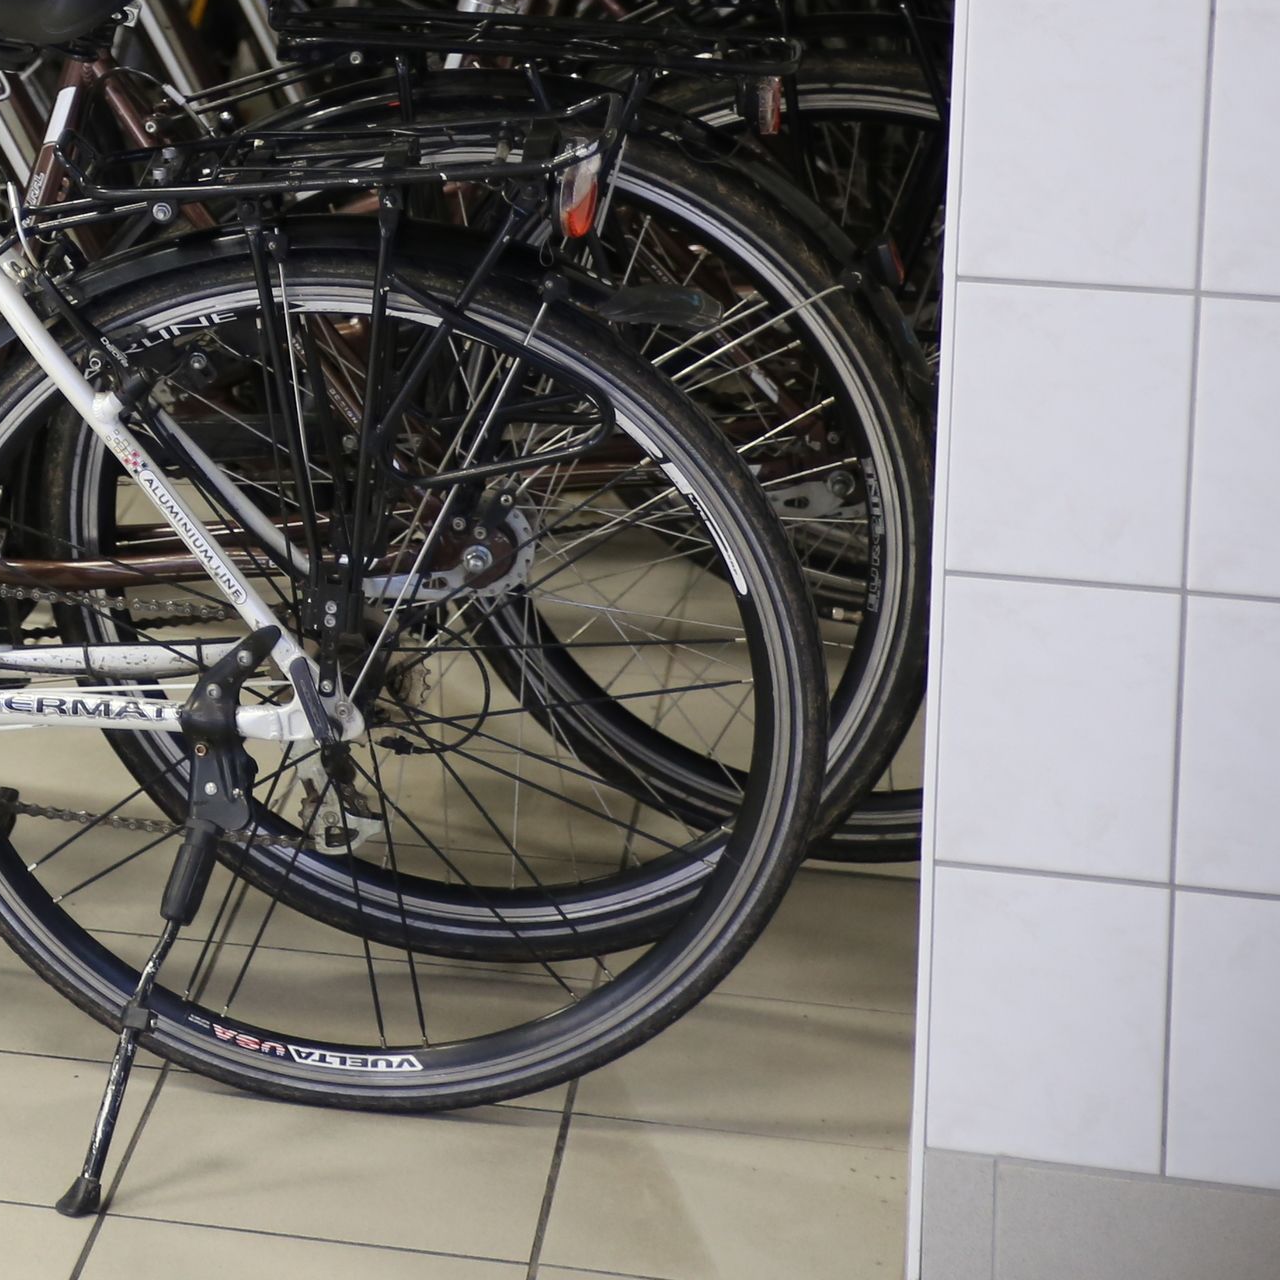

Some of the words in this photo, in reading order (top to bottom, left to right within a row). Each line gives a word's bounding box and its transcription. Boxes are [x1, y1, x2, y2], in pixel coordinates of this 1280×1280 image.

[143, 477, 214, 565] ALUMINIUM
[214, 568, 243, 603] LINE
[212, 1023, 286, 1057] USA
[293, 1047, 417, 1070] VUELTA
